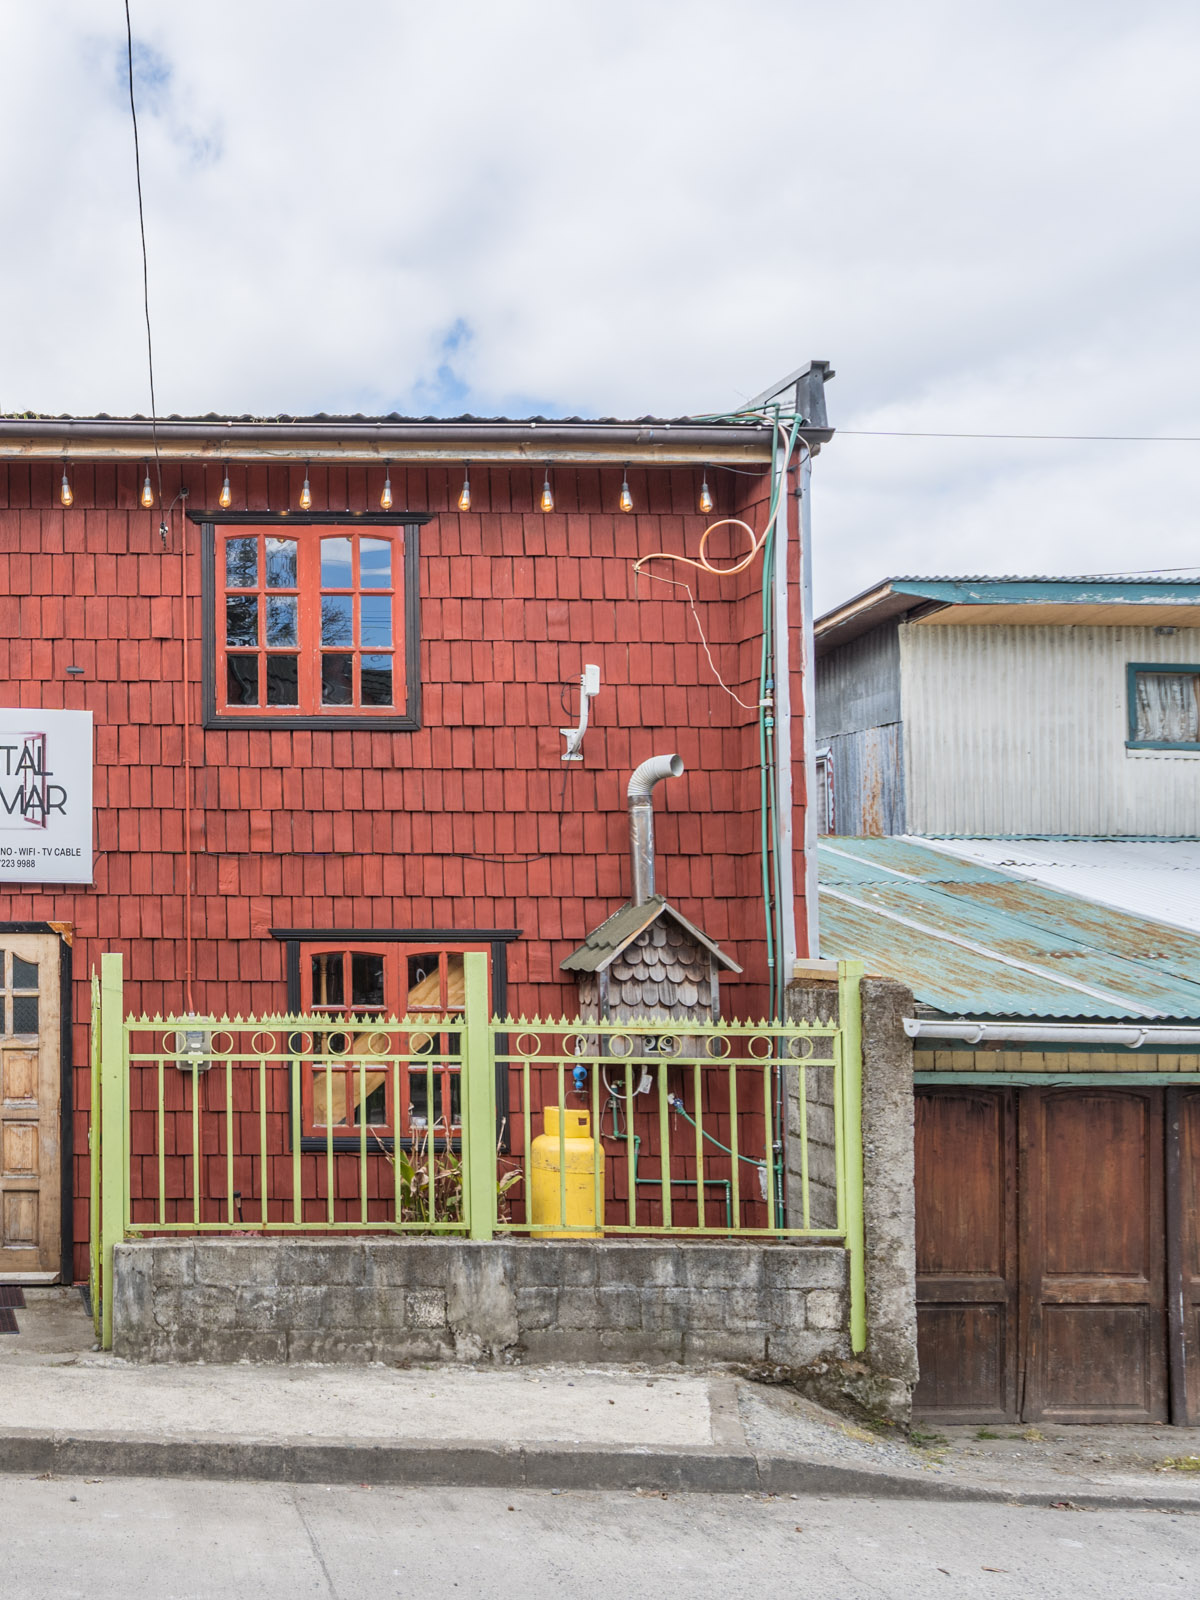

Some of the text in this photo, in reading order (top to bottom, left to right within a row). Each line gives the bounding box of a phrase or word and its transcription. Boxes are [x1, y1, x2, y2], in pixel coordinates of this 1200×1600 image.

[18, 847, 36, 856] WIFI
[42, 848, 53, 856] TV
[54, 848, 81, 857] CABLE
[16, 859, 36, 868] 9988
